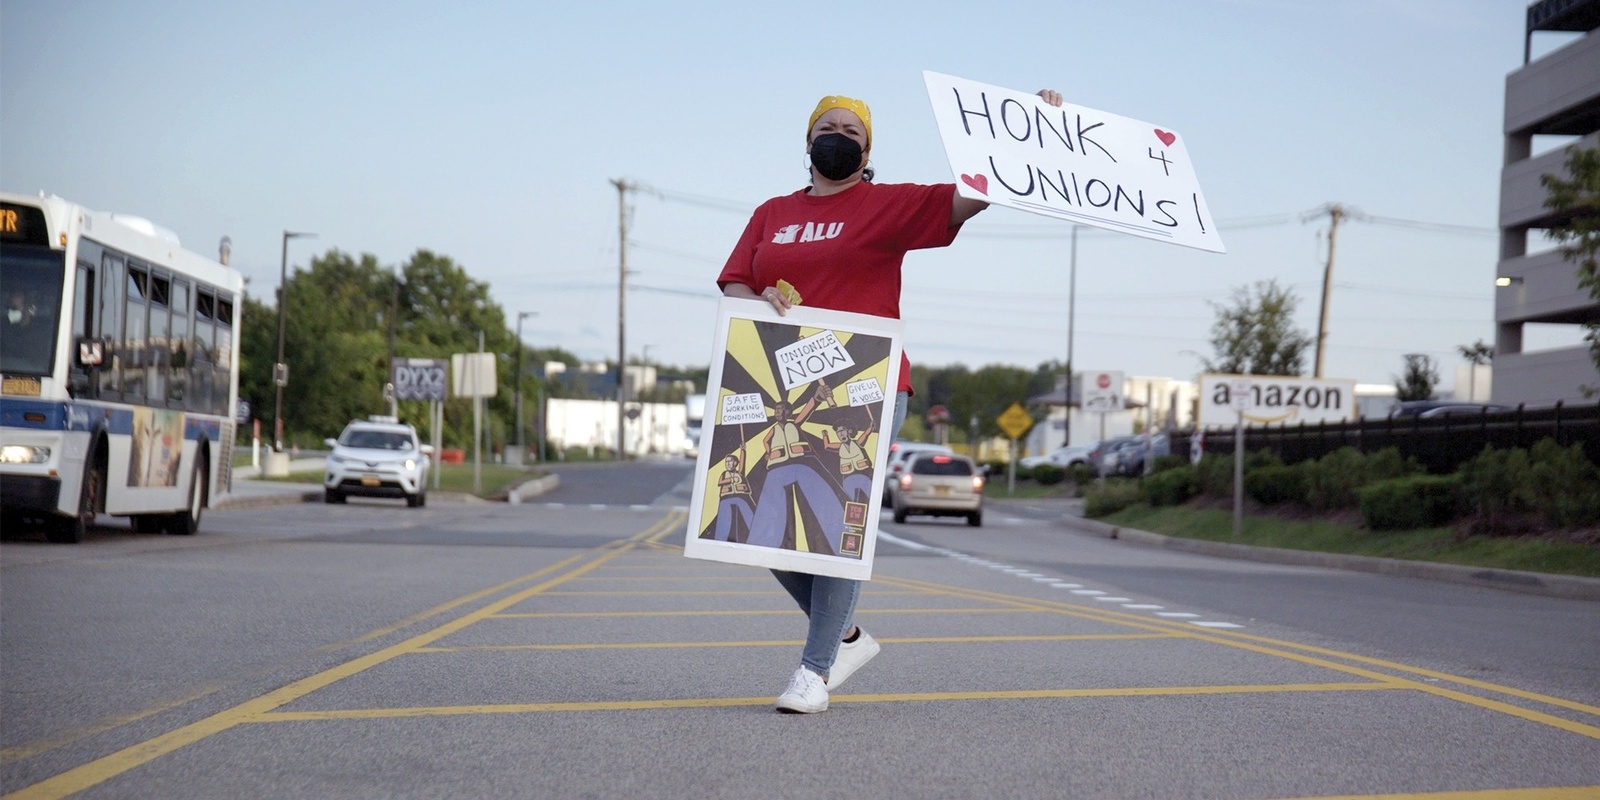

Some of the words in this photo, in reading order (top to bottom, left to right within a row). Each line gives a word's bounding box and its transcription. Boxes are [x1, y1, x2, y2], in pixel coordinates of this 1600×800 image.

[953, 87, 1117, 163] HONK
[1149, 147, 1173, 176] 4
[799, 221, 844, 242] ALU
[780, 334, 836, 364] UNIONIZE
[786, 346, 846, 385] NOW
[848, 383, 866, 394] GIVE
[867, 381, 877, 390] US
[727, 395, 759, 405] SAFE
[852, 396, 859, 404] A
[859, 391, 881, 402] VOICE
[726, 404, 760, 413] WORKING
[723, 412, 765, 422] CONDITIONS
